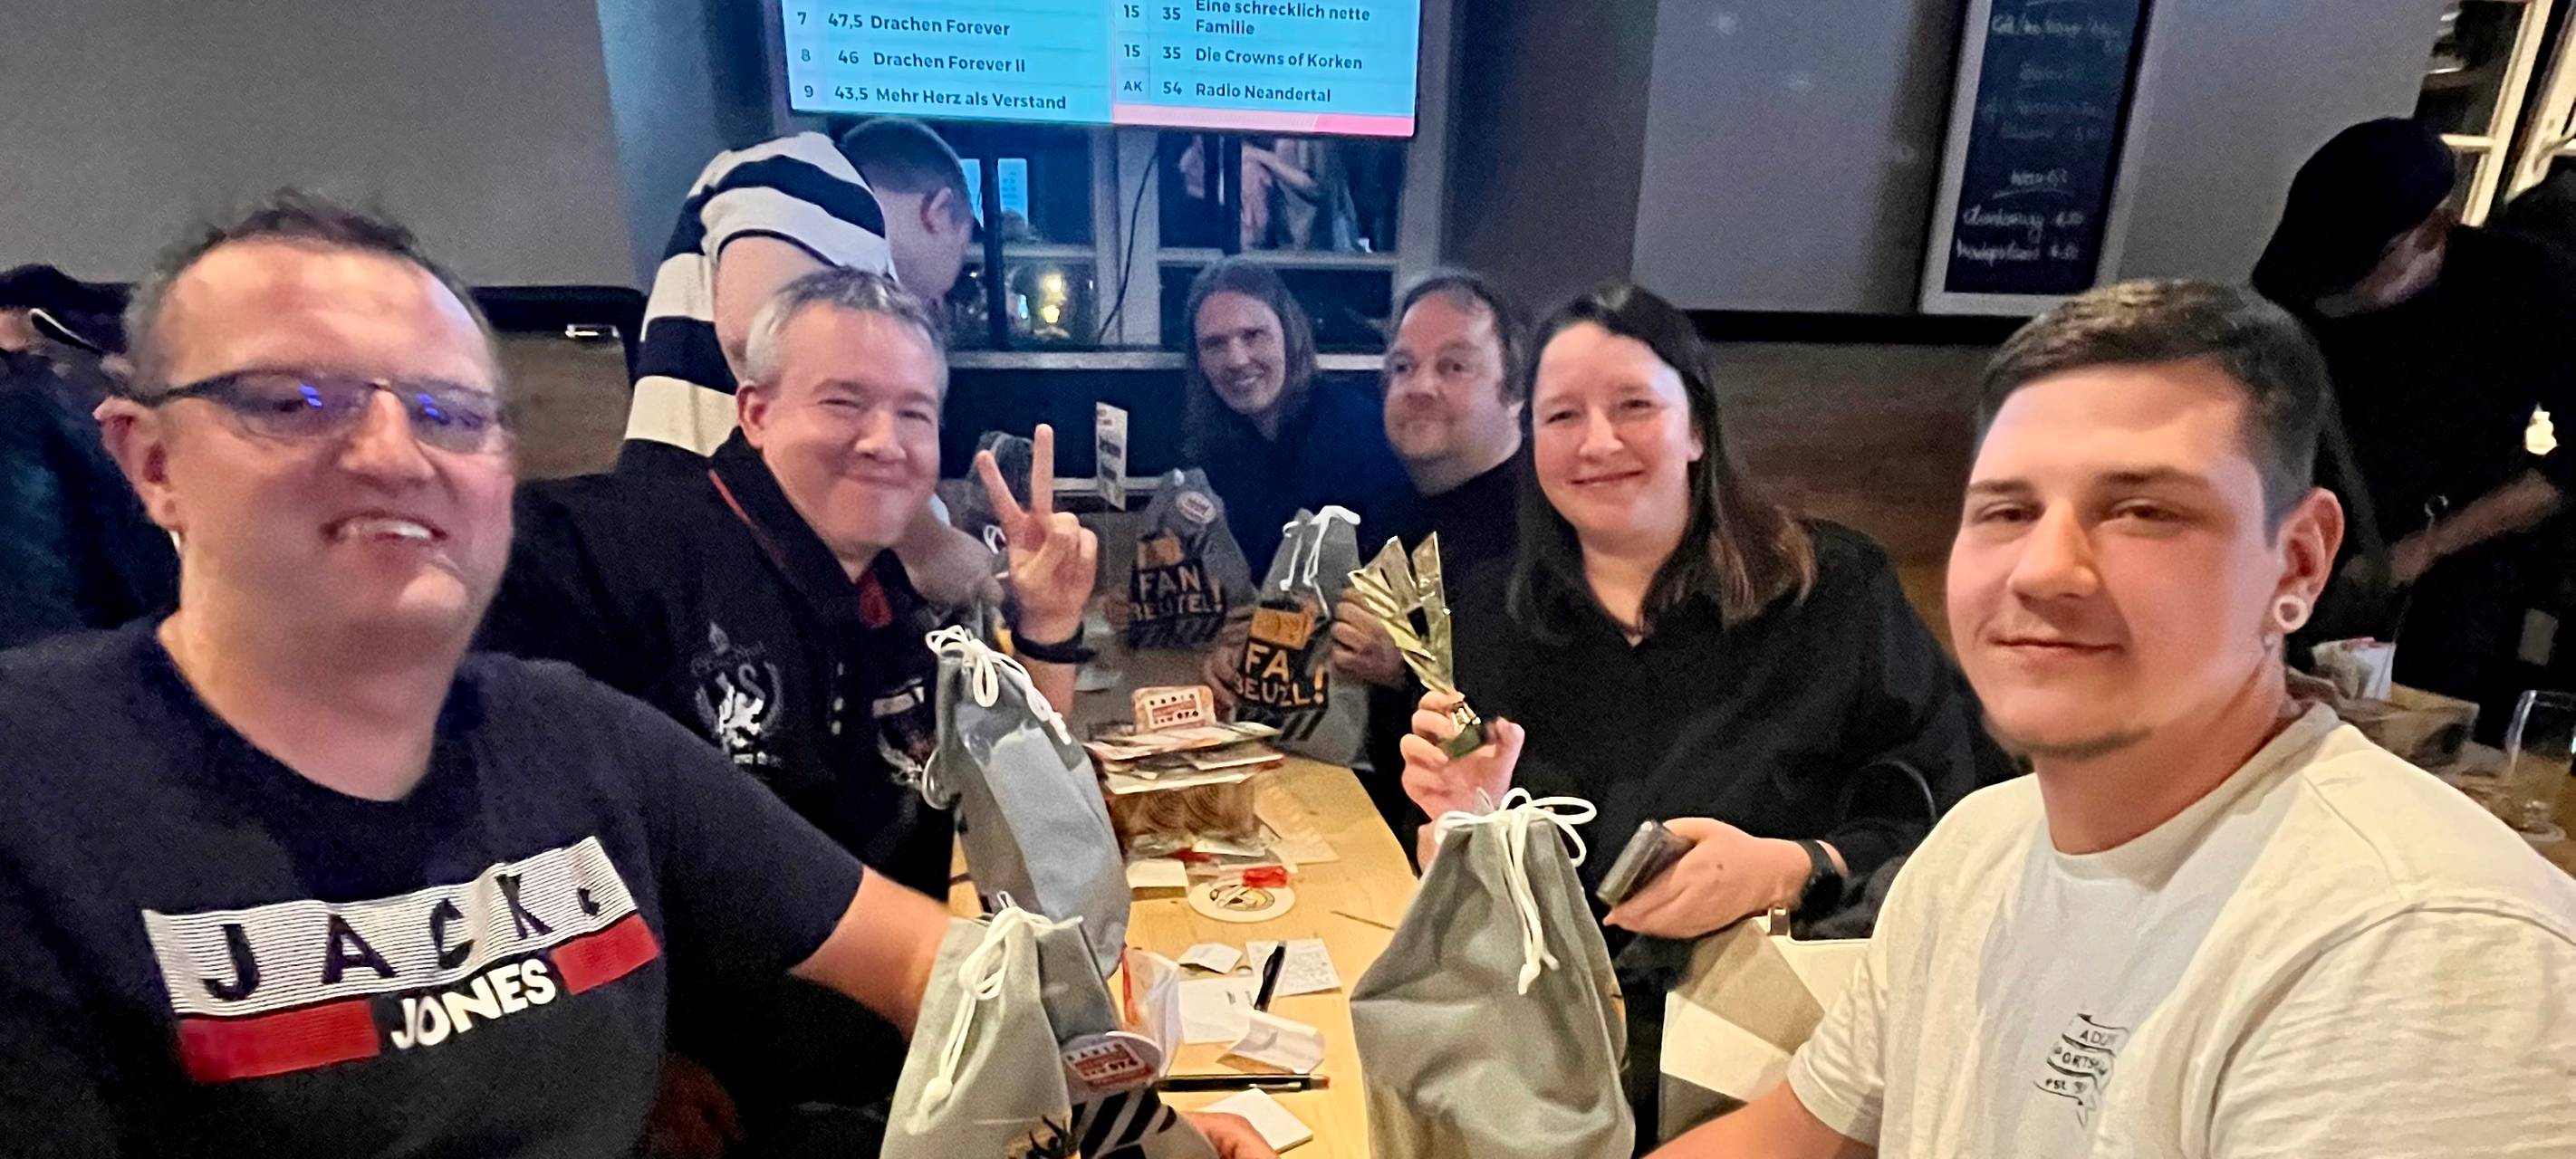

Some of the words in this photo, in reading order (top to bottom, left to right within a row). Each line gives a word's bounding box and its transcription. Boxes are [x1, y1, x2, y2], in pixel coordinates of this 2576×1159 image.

[796, 11, 807, 25] 7
[828, 13, 863, 30] 47,5
[870, 14, 942, 33] Drachen
[946, 19, 1011, 36] Forever
[1123, 4, 1140, 18] 15
[1162, 6, 1181, 21] 35
[1235, 0, 1325, 19] schrecklich
[1329, 7, 1370, 22] nette
[1196, 19, 1255, 35] Familie
[801, 48, 812, 62] 8
[838, 50, 860, 64] 46
[873, 52, 945, 69] Drachen
[948, 55, 1013, 72] Forever
[1123, 43, 1140, 58] 15
[1162, 45, 1181, 60] 35
[1196, 46, 1221, 62] Die
[1225, 49, 1284, 66] Crowns
[1288, 52, 1305, 67] of
[1307, 53, 1362, 70] Korken
[803, 84, 814, 98] 9
[876, 87, 919, 103] Mehr
[922, 90, 962, 105] Herz
[965, 91, 989, 106] als
[992, 92, 1066, 110] Verstand
[1123, 81, 1143, 92] AK
[1163, 81, 1183, 95] 54
[1196, 82, 1241, 99] Radio
[1245, 84, 1331, 102] Neandertal
[1139, 565, 1202, 599] FAN
[1245, 641, 1291, 684] FA
[204, 872, 554, 1002] JACK
[390, 959, 557, 1049] JONES
